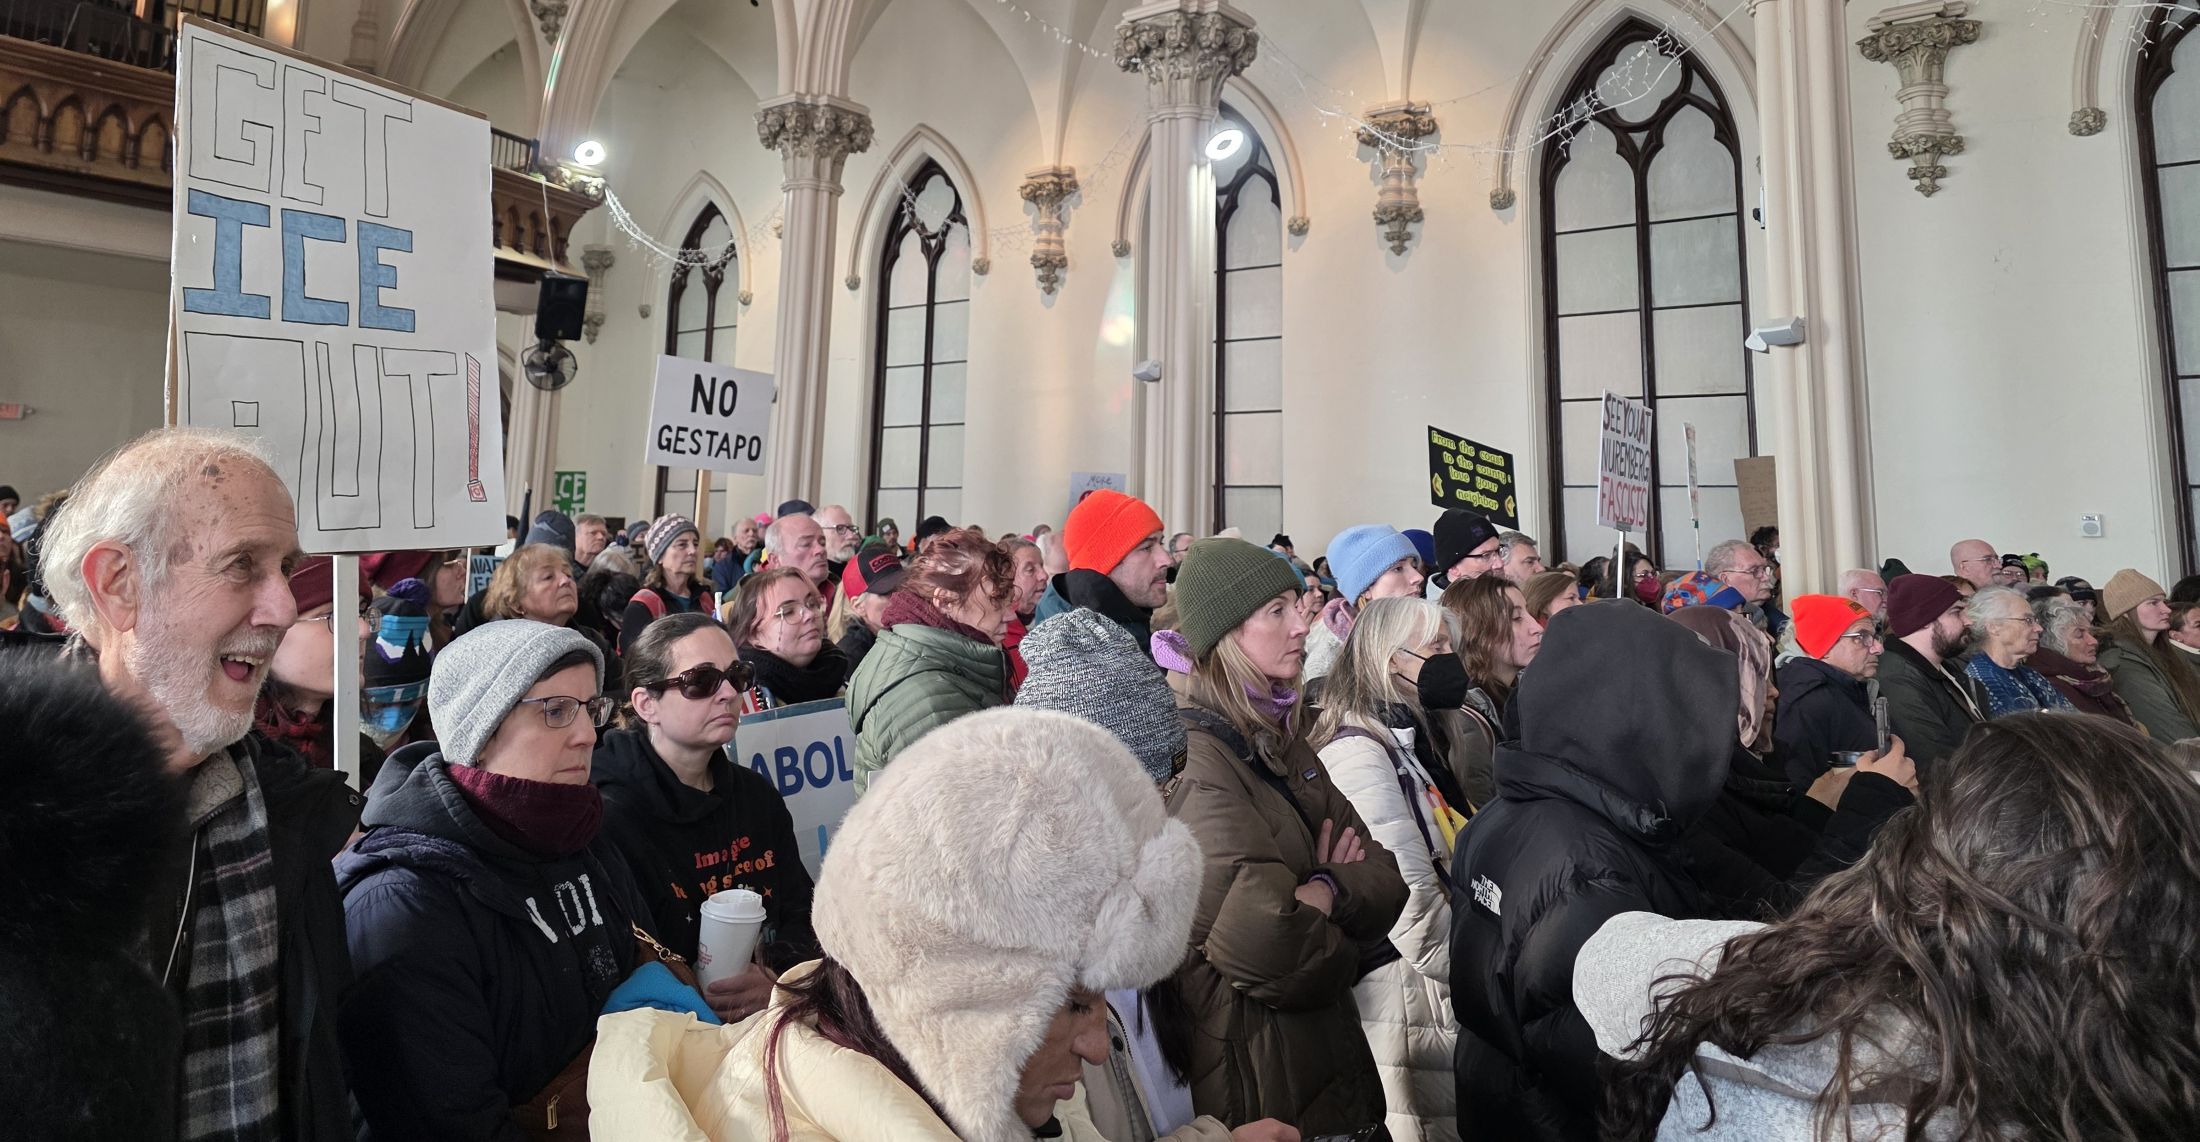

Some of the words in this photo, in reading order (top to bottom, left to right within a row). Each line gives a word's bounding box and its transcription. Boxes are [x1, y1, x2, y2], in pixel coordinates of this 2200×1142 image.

[188, 36, 413, 218] GET
[183, 187, 416, 332] ICE
[690, 373, 738, 418] NO
[1603, 393, 1622, 434] SEE
[184, 331, 487, 531] OUT!
[657, 424, 762, 462] GESTAPO
[1431, 430, 1456, 450] From
[1459, 440, 1475, 457] the
[1479, 450, 1504, 467] coast
[1443, 451, 1454, 464] to
[1456, 454, 1473, 470] the
[1448, 465, 1470, 483] love
[1475, 476, 1498, 493] your
[1601, 438, 1650, 482] NUREMBERG
[1456, 489, 1499, 510] neighbor
[1600, 476, 1647, 527] FASCISTS
[1471, 878, 1494, 902] NORTH
[1474, 889, 1492, 908] FACE
[1481, 874, 1494, 891] THE
